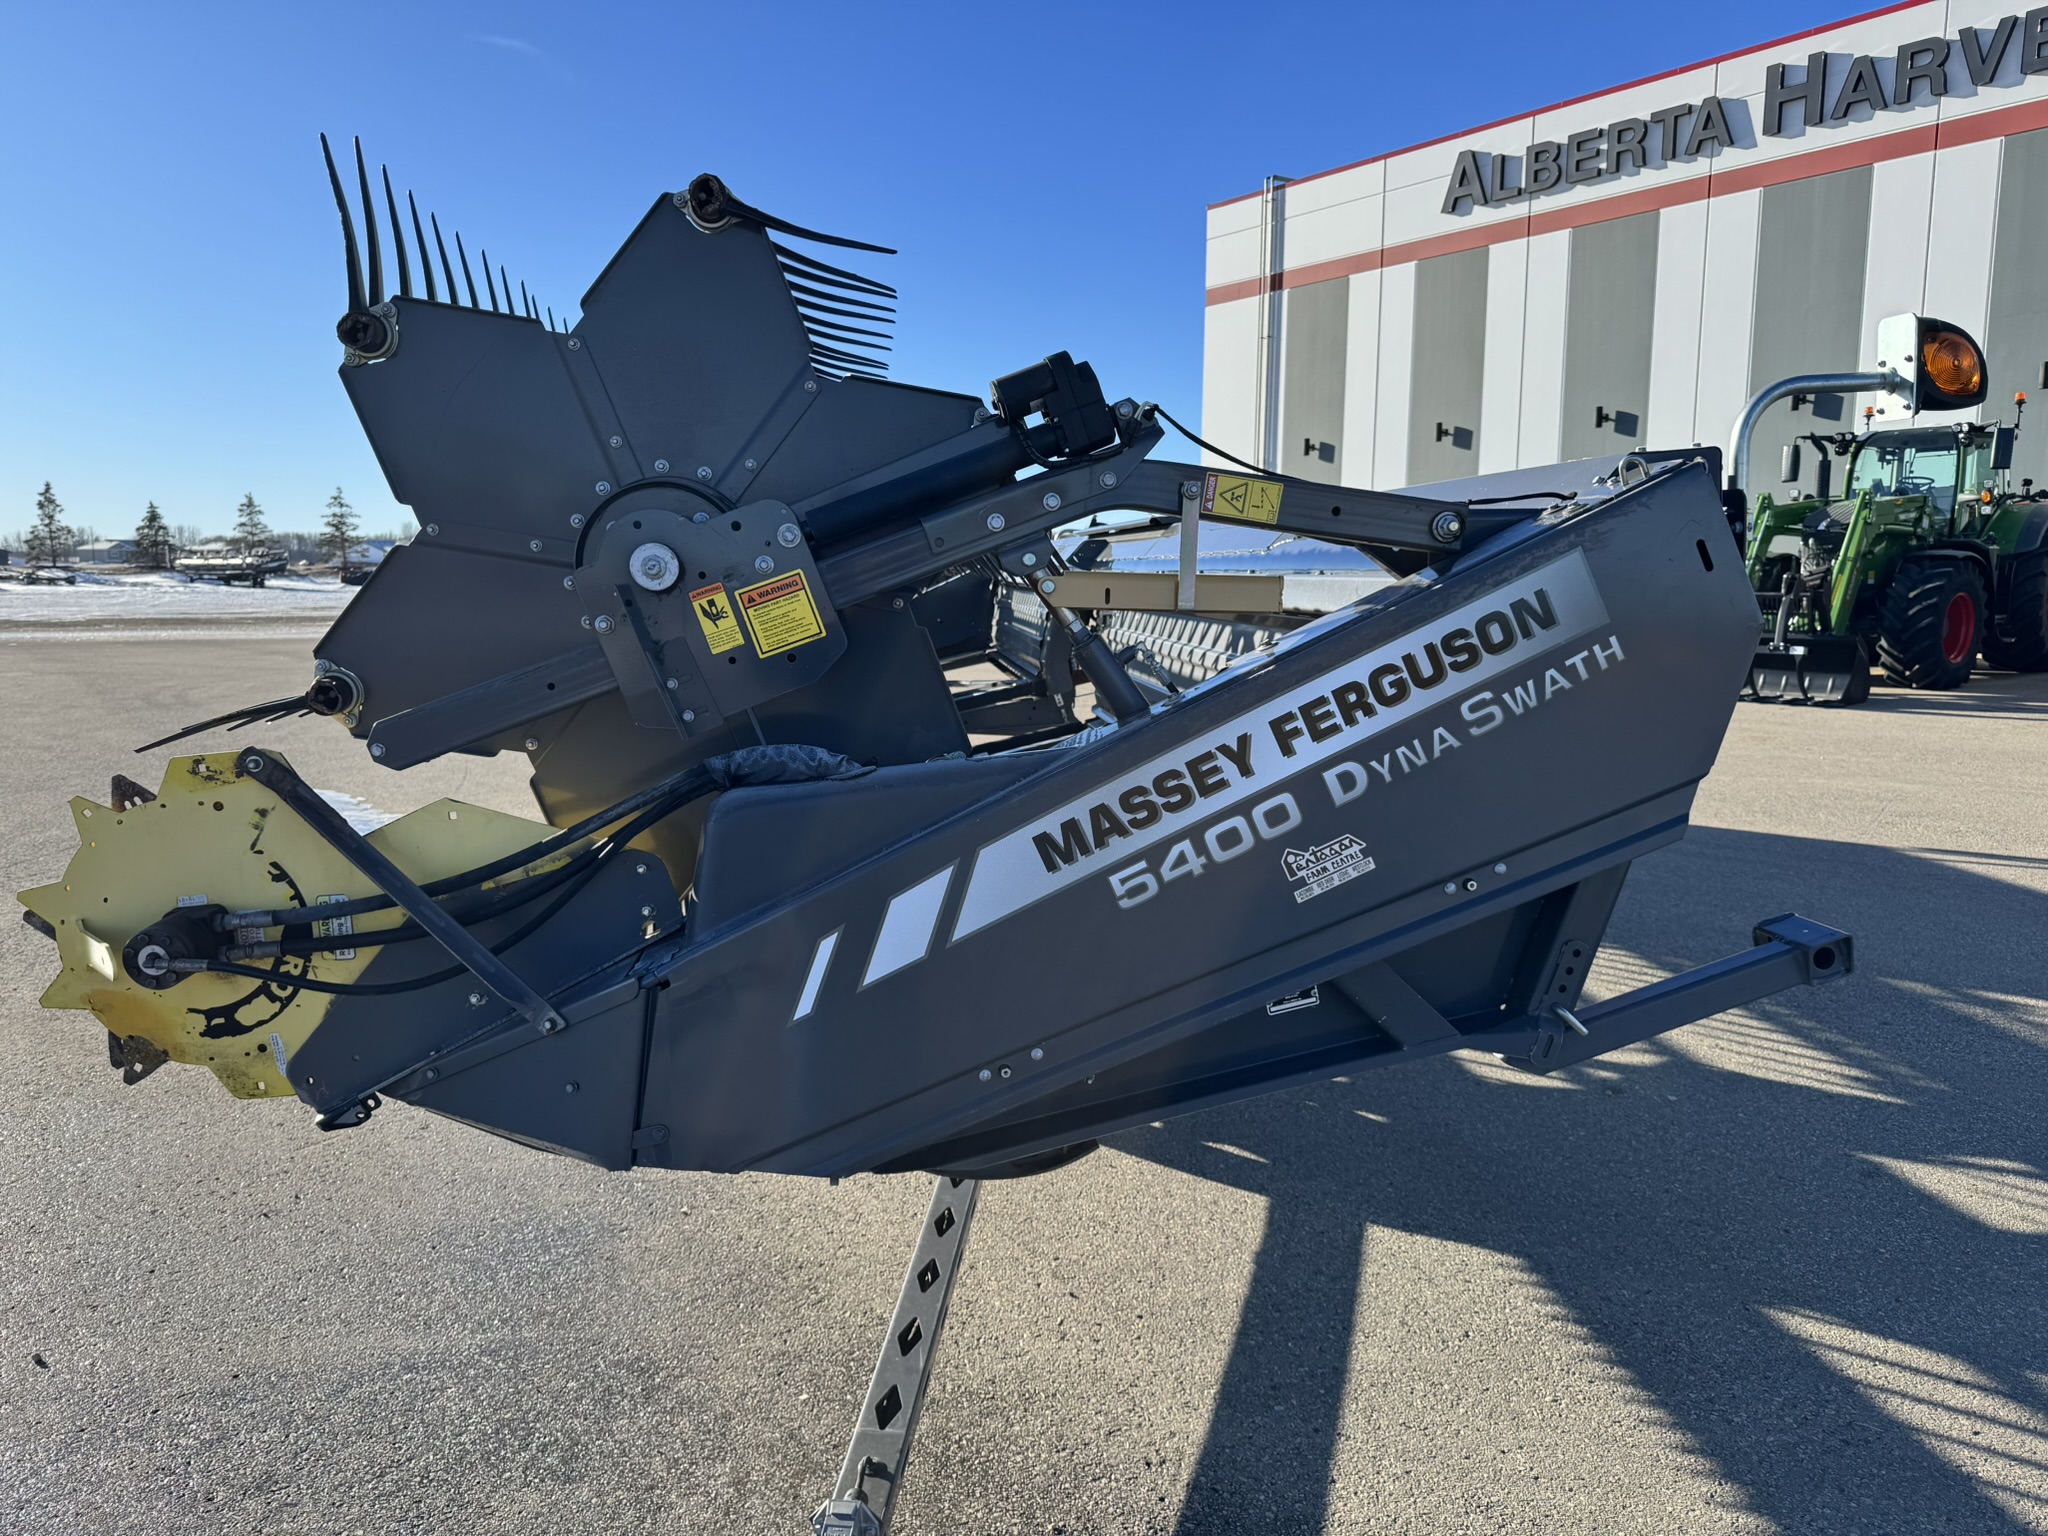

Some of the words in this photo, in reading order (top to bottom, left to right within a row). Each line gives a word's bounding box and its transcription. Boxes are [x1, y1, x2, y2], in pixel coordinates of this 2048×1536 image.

[1441, 96, 1734, 214] ALBERTA
[1206, 476, 1217, 500] DANGER
[757, 580, 799, 599] WARNING
[1032, 732, 1255, 874] MASSEY
[1268, 587, 1560, 759] FERGUSON
[1108, 791, 1303, 911] 5400
[1306, 866, 1330, 882] FARM
[1331, 851, 1361, 870] CENTRE
